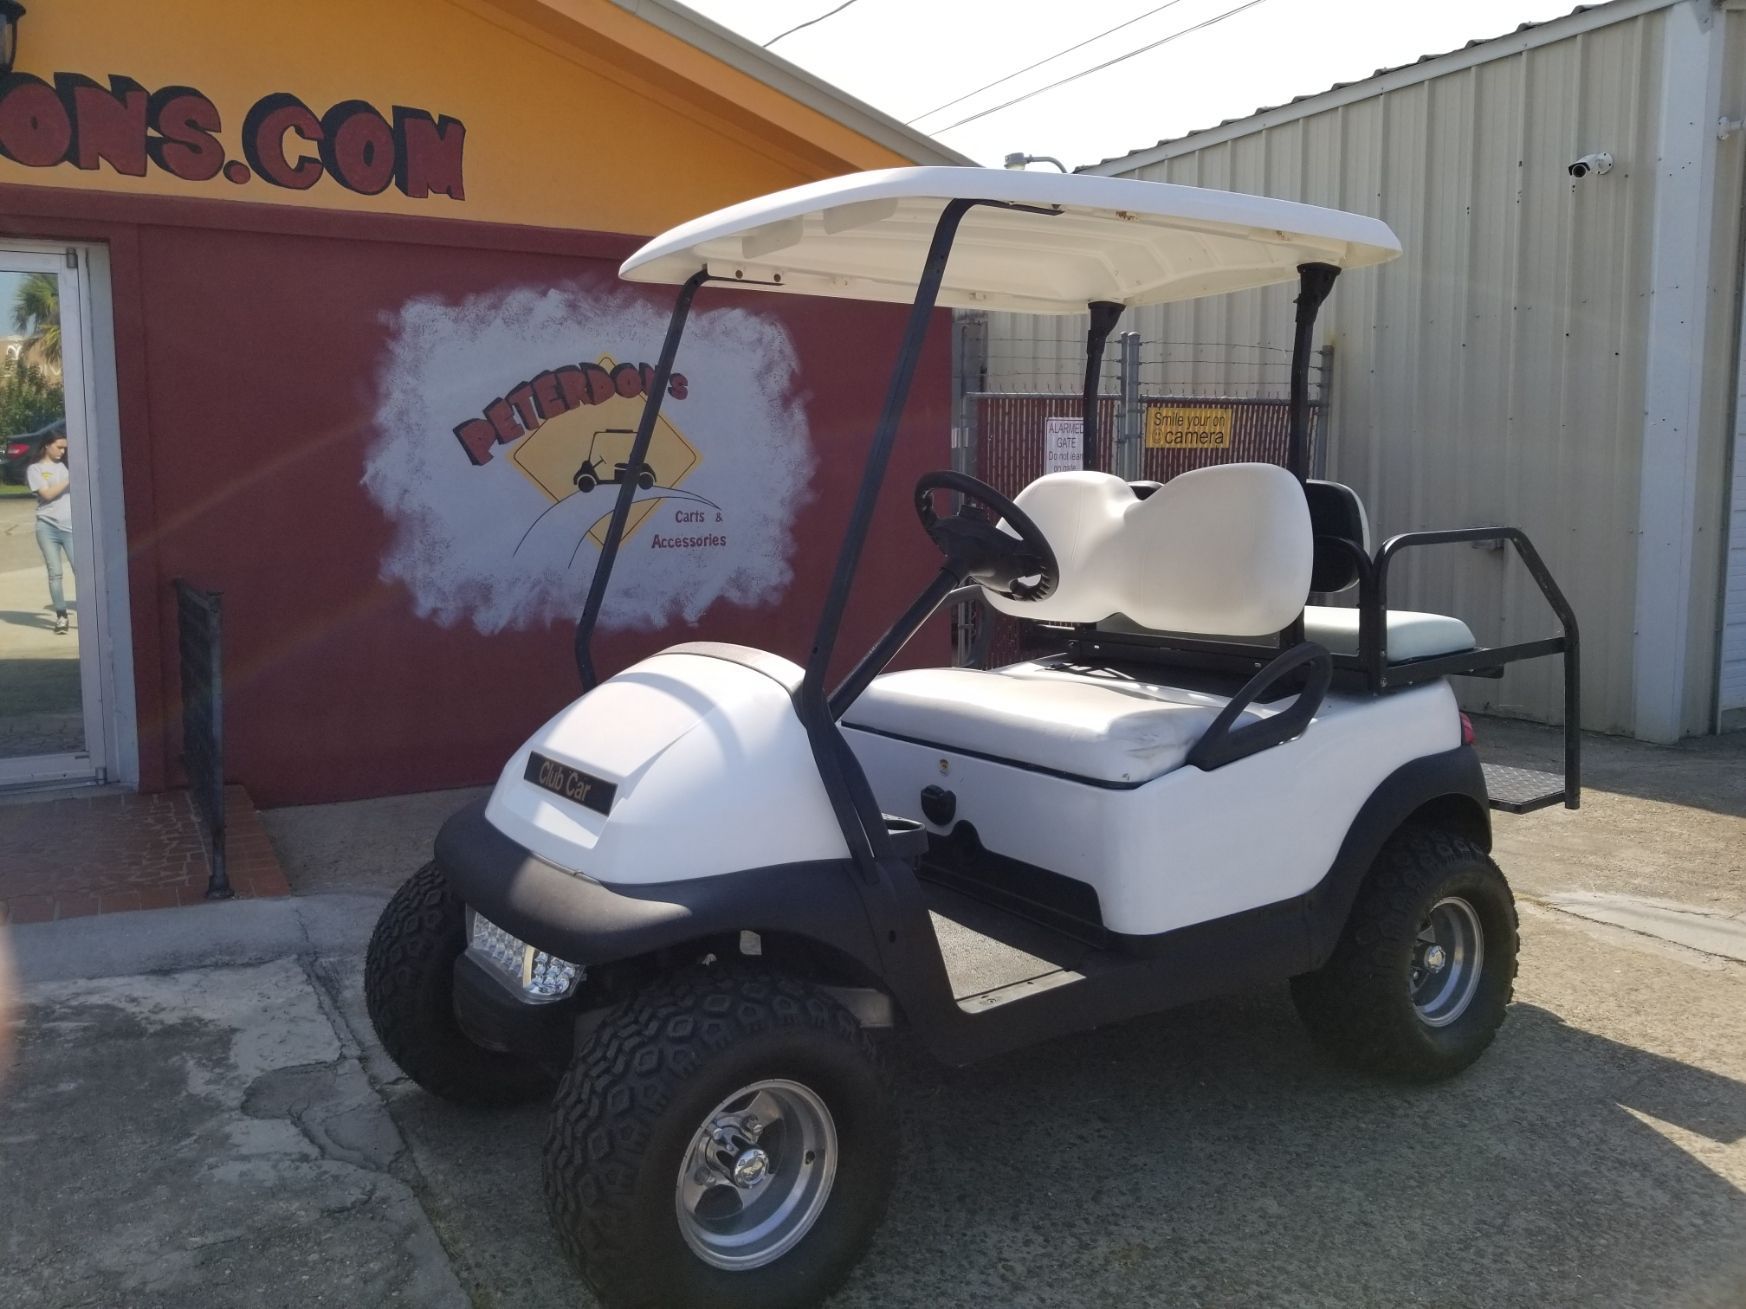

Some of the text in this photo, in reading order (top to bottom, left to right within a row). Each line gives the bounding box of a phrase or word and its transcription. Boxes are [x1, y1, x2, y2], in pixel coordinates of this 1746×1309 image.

[1154, 412, 1225, 430] Smile your on
[1057, 437, 1077, 449] GATE
[1165, 431, 1224, 444] camera
[1048, 451, 1058, 461] Do
[675, 510, 723, 523] Carts &
[651, 533, 727, 549] Accessories
[539, 761, 592, 801] Club Car
